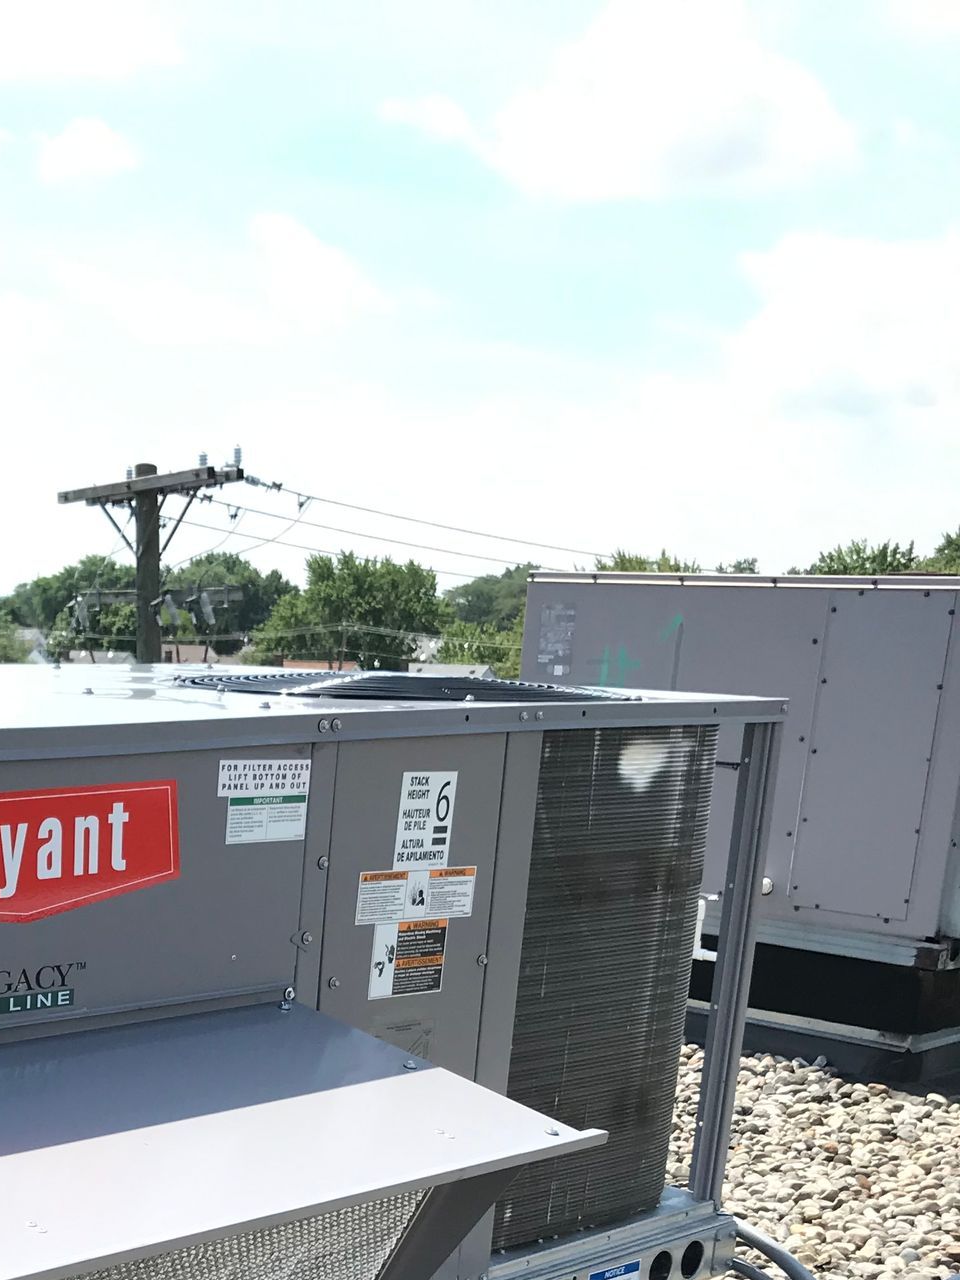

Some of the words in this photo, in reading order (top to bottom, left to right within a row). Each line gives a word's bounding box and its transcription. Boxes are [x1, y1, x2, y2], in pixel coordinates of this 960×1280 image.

[221, 764, 238, 772] FOR
[243, 764, 273, 772] FILTER
[277, 764, 309, 772] ACCESS
[228, 773, 248, 781] LIFT
[252, 773, 287, 781] BOTTOM
[409, 776, 431, 787] STACK
[221, 783, 249, 791] PANEL
[269, 782, 286, 790] AND
[407, 789, 431, 800] HEIGHT
[253, 797, 283, 805] IMPORTANT
[435, 780, 451, 822] 6
[402, 808, 431, 819] HAUTEUR
[403, 820, 413, 831] DE
[413, 820, 427, 831] PILE
[401, 839, 424, 849] ALTURA
[396, 852, 405, 862] DE
[405, 850, 444, 862] APILAMIENTO
[412, 920, 439, 929] WARNING
[8, 990, 71, 1012] LINE
[604, 1266, 626, 1279] NOTICE
